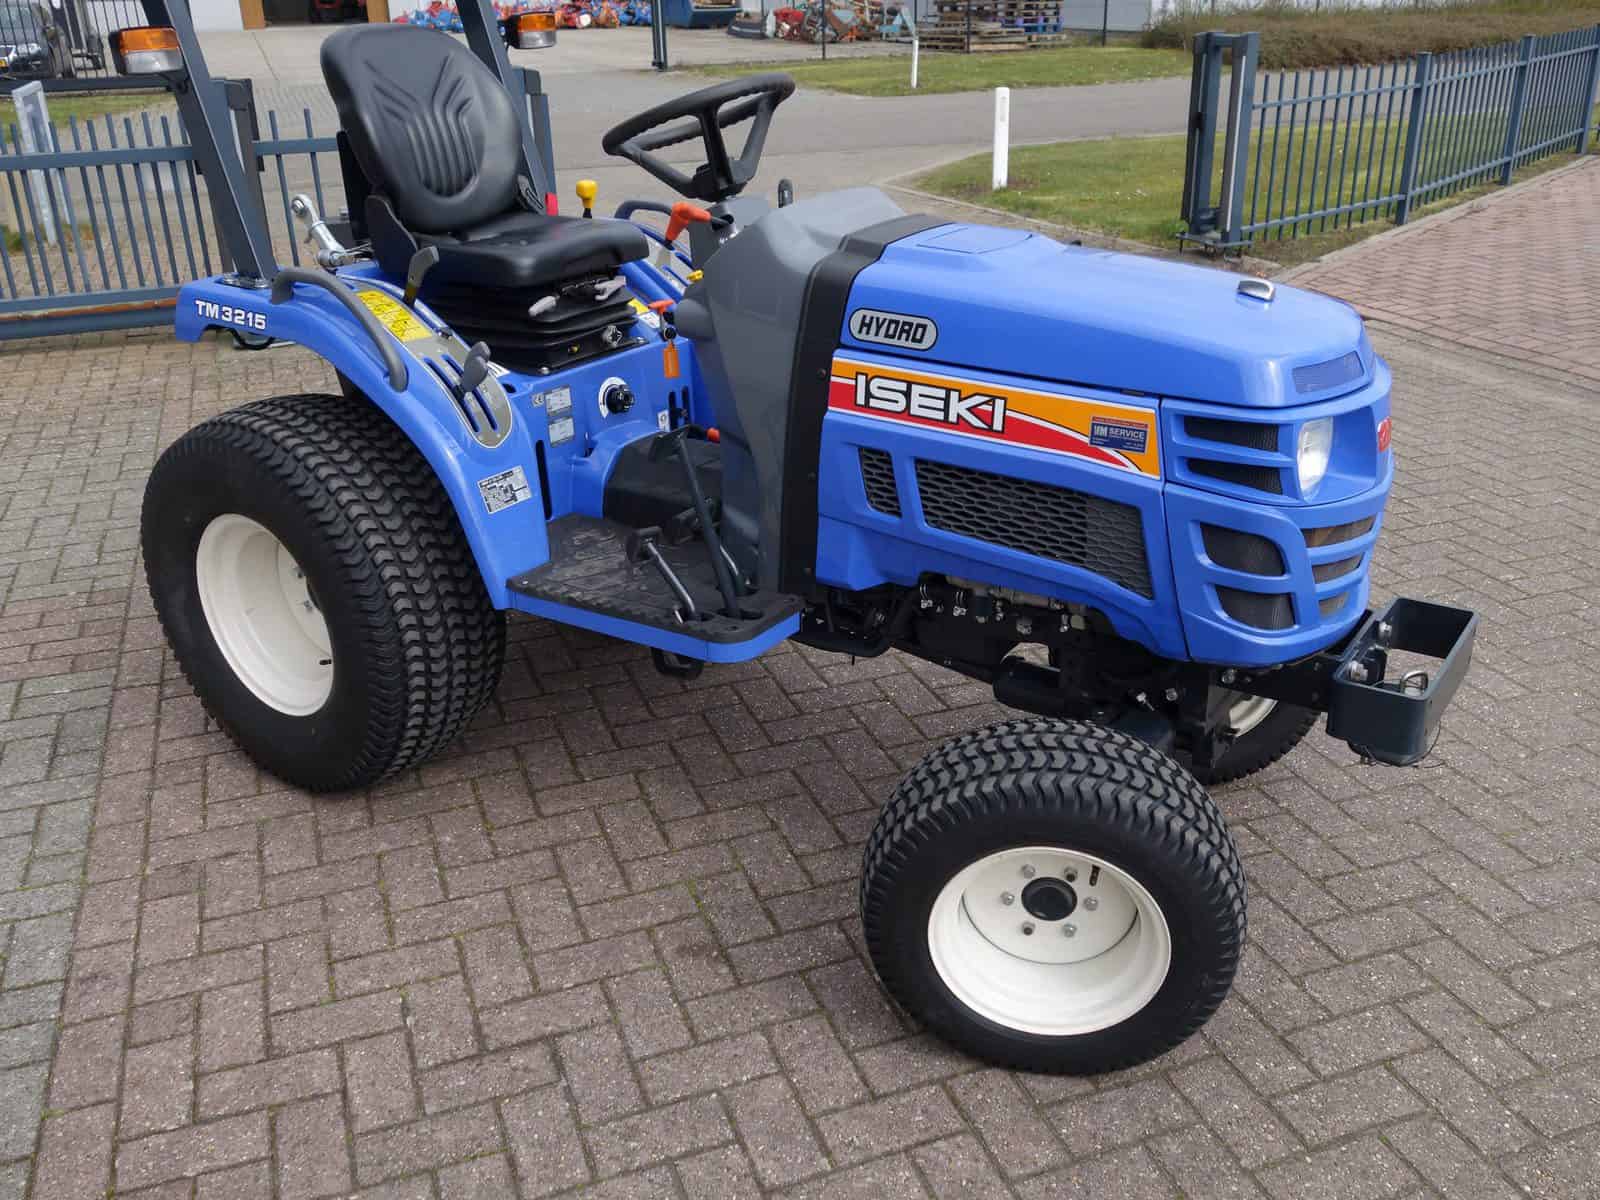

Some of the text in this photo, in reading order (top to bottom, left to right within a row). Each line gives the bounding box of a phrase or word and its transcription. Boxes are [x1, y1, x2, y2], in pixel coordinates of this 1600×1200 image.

[858, 314, 928, 344] HYDRO
[855, 371, 1007, 434] ISEKI
[1109, 427, 1145, 440] SERVICE
